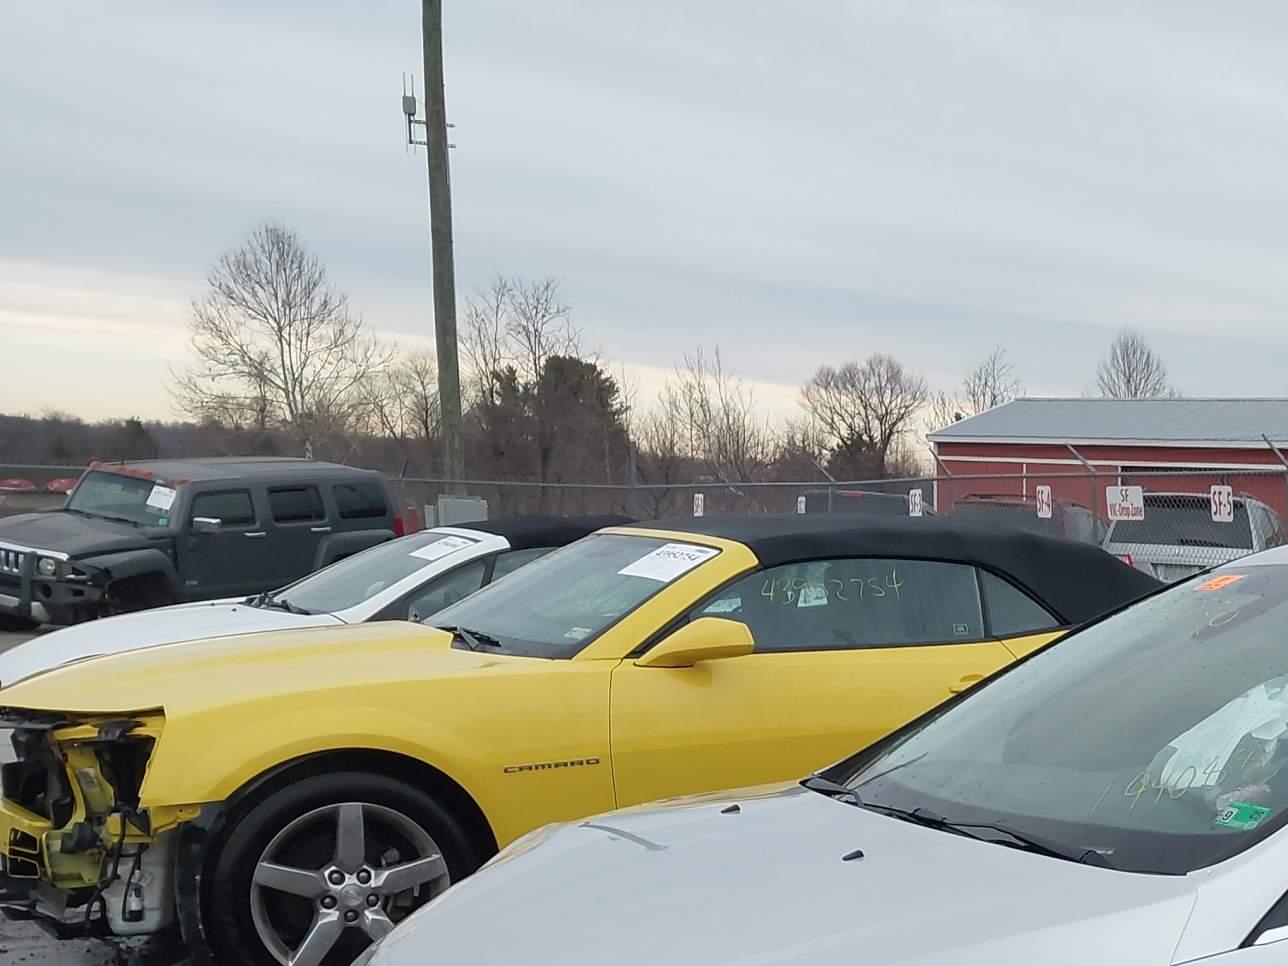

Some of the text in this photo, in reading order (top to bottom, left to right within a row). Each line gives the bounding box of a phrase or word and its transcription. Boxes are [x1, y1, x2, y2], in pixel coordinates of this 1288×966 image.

[910, 493, 922, 513] SF-3
[1036, 490, 1051, 513] SF-4
[1119, 488, 1129, 503] SF
[1212, 489, 1232, 517] SF-5
[503, 757, 600, 774] CAMARO
